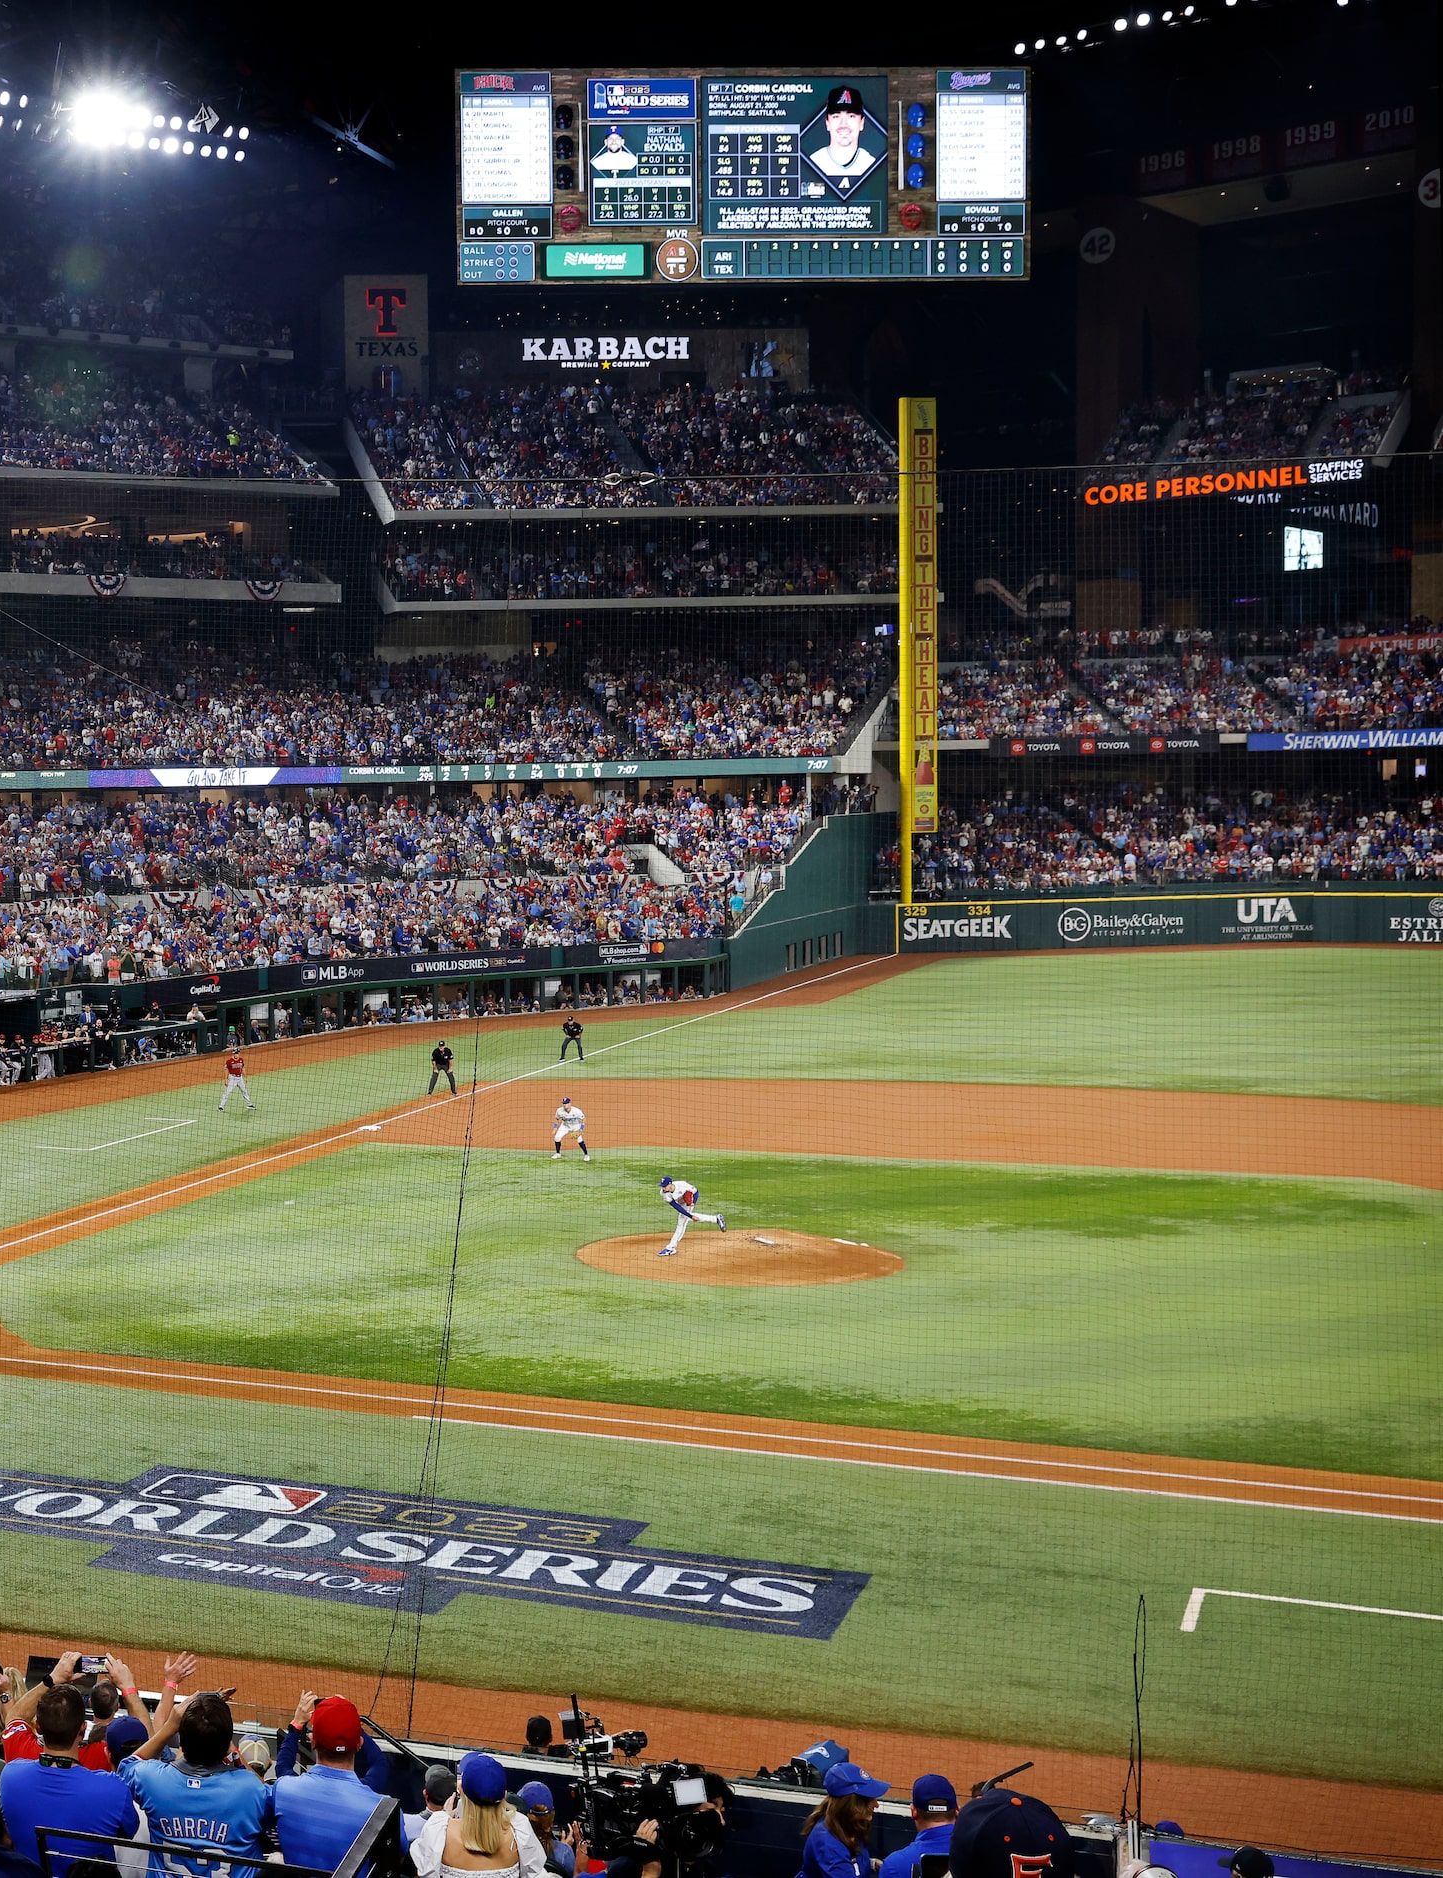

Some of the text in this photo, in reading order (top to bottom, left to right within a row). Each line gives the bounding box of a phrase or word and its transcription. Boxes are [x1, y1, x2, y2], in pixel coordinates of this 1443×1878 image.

[625, 86, 650, 94] 2023
[735, 84, 813, 93] CORBIN CARROLL
[607, 95, 689, 106] WORLD SERIES
[1365, 105, 1414, 131] 2010
[1285, 120, 1336, 146] 1999
[644, 144, 685, 152] EOVALDI
[1213, 135, 1261, 160] 1998
[1140, 150, 1186, 174] 1996
[492, 209, 523, 217] GALLEN
[965, 206, 999, 214] EOVALDI
[722, 214, 757, 222] LAKESIDE
[666, 229, 688, 239] MVR
[463, 247, 485, 255] BALL
[1084, 234, 1111, 257] 42
[463, 259, 494, 267] STRIKE
[578, 252, 627, 265] National
[714, 252, 732, 262] ARI
[463, 271, 483, 279] OUT
[714, 264, 733, 275] TEX
[366, 287, 407, 336] T
[355, 341, 418, 357] TEXAS
[522, 336, 690, 361] KARBACH
[612, 360, 651, 368] COMPANY
[1308, 459, 1364, 473] STAFFING
[1309, 469, 1363, 484] SERVICES
[1084, 465, 1308, 505] CORE PERSONNEL
[918, 436, 929, 553] BRING
[919, 563, 930, 633] THE
[919, 642, 930, 733] HEAT
[1027, 742, 1060, 752] TOYOTA
[1097, 741, 1130, 750] TOYOTA
[1167, 740, 1199, 749] TOYOTA
[617, 765, 638, 775] 7:07
[807, 759, 828, 769] 7:07
[348, 766, 405, 775] CORBIN CARROLL
[530, 770, 543, 779] 54
[904, 905, 991, 916] 329 334
[1236, 898, 1297, 923] UTA
[903, 914, 1012, 942] SEATGEEK
[1093, 914, 1184, 930] Bailey&Galyen
[1221, 926, 1236, 934] THE
[1237, 925, 1279, 933] UNIVERSITY
[1251, 932, 1293, 940] ARLINGTON
[424, 957, 489, 972] WORLD SERIES
[319, 966, 365, 980] MLB App
[323, 1494, 601, 1546] 2023
[156, 1550, 405, 1597] CapitalOne
[339, 1530, 818, 1612] SERIES
[160, 1817, 228, 1844] GARCIA
